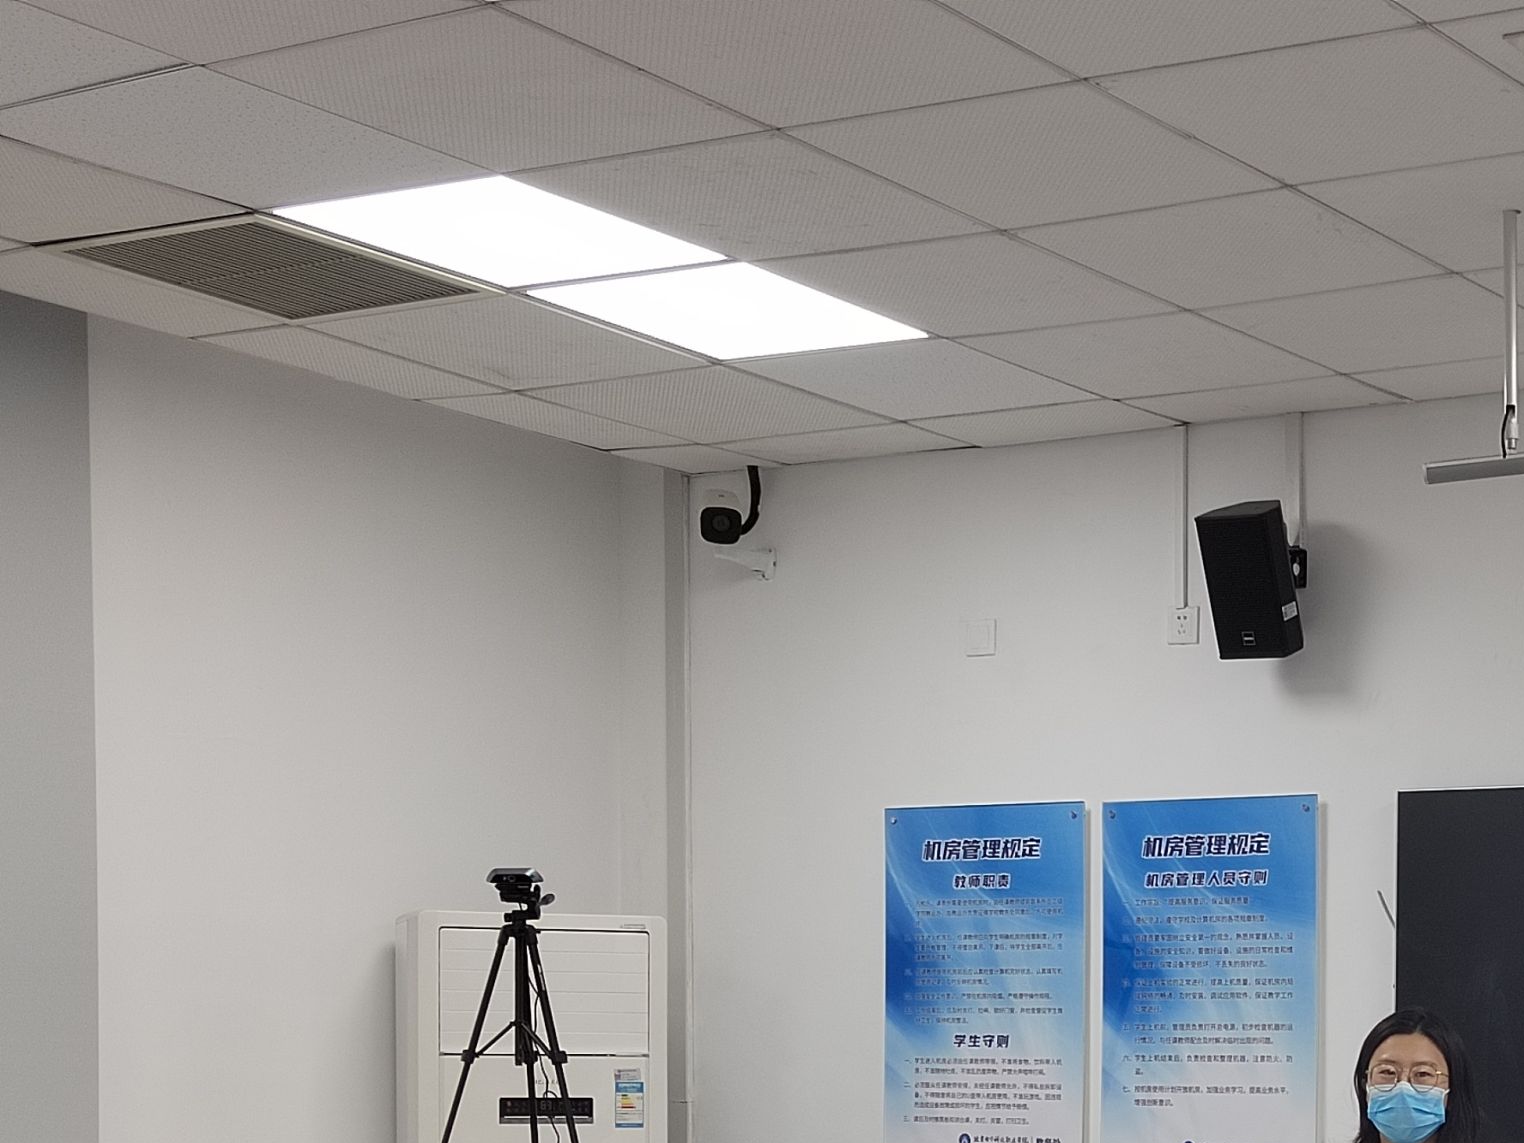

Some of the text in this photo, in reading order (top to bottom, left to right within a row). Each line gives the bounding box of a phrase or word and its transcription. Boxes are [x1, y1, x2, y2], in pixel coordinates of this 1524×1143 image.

[923, 838, 1041, 860] 机房管理规定
[1143, 833, 1270, 857] 机房管理规定
[954, 874, 1009, 888] 教师职责
[1146, 871, 1267, 887] 机房管理人员守则
[954, 1034, 1009, 1048] 学生守则
